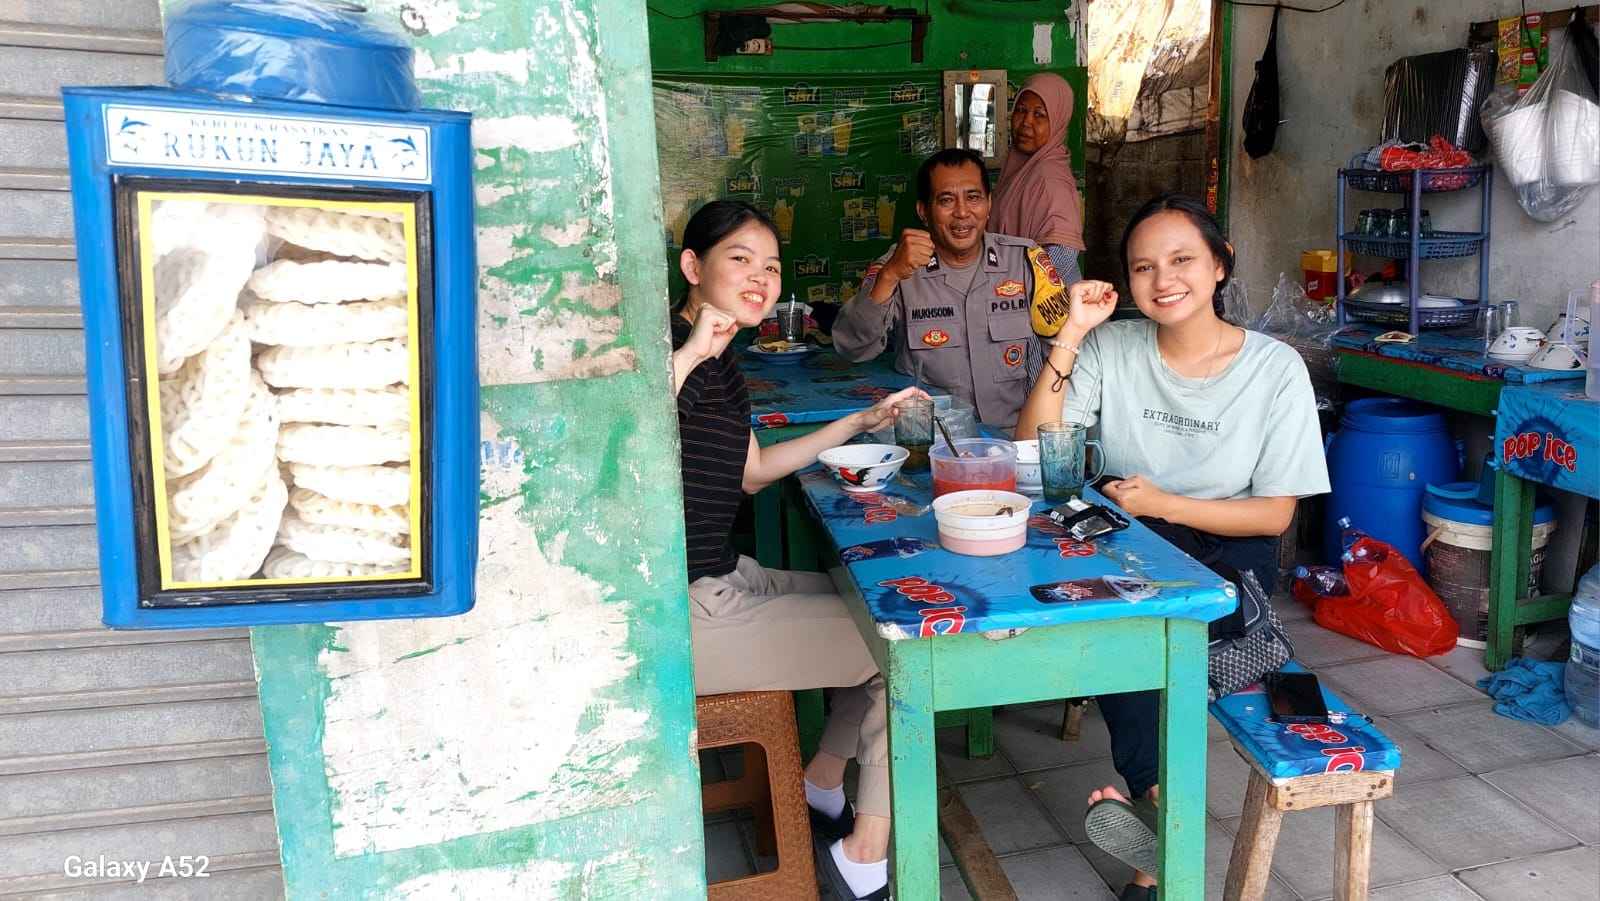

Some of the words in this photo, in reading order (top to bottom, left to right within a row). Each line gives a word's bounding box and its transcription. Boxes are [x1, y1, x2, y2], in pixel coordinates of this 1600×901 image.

[164, 131, 278, 163] RUKUN
[299, 140, 379, 170] JAYA
[1143, 408, 1221, 431] EXTRAORDINARY
[1503, 431, 1541, 465] POP
